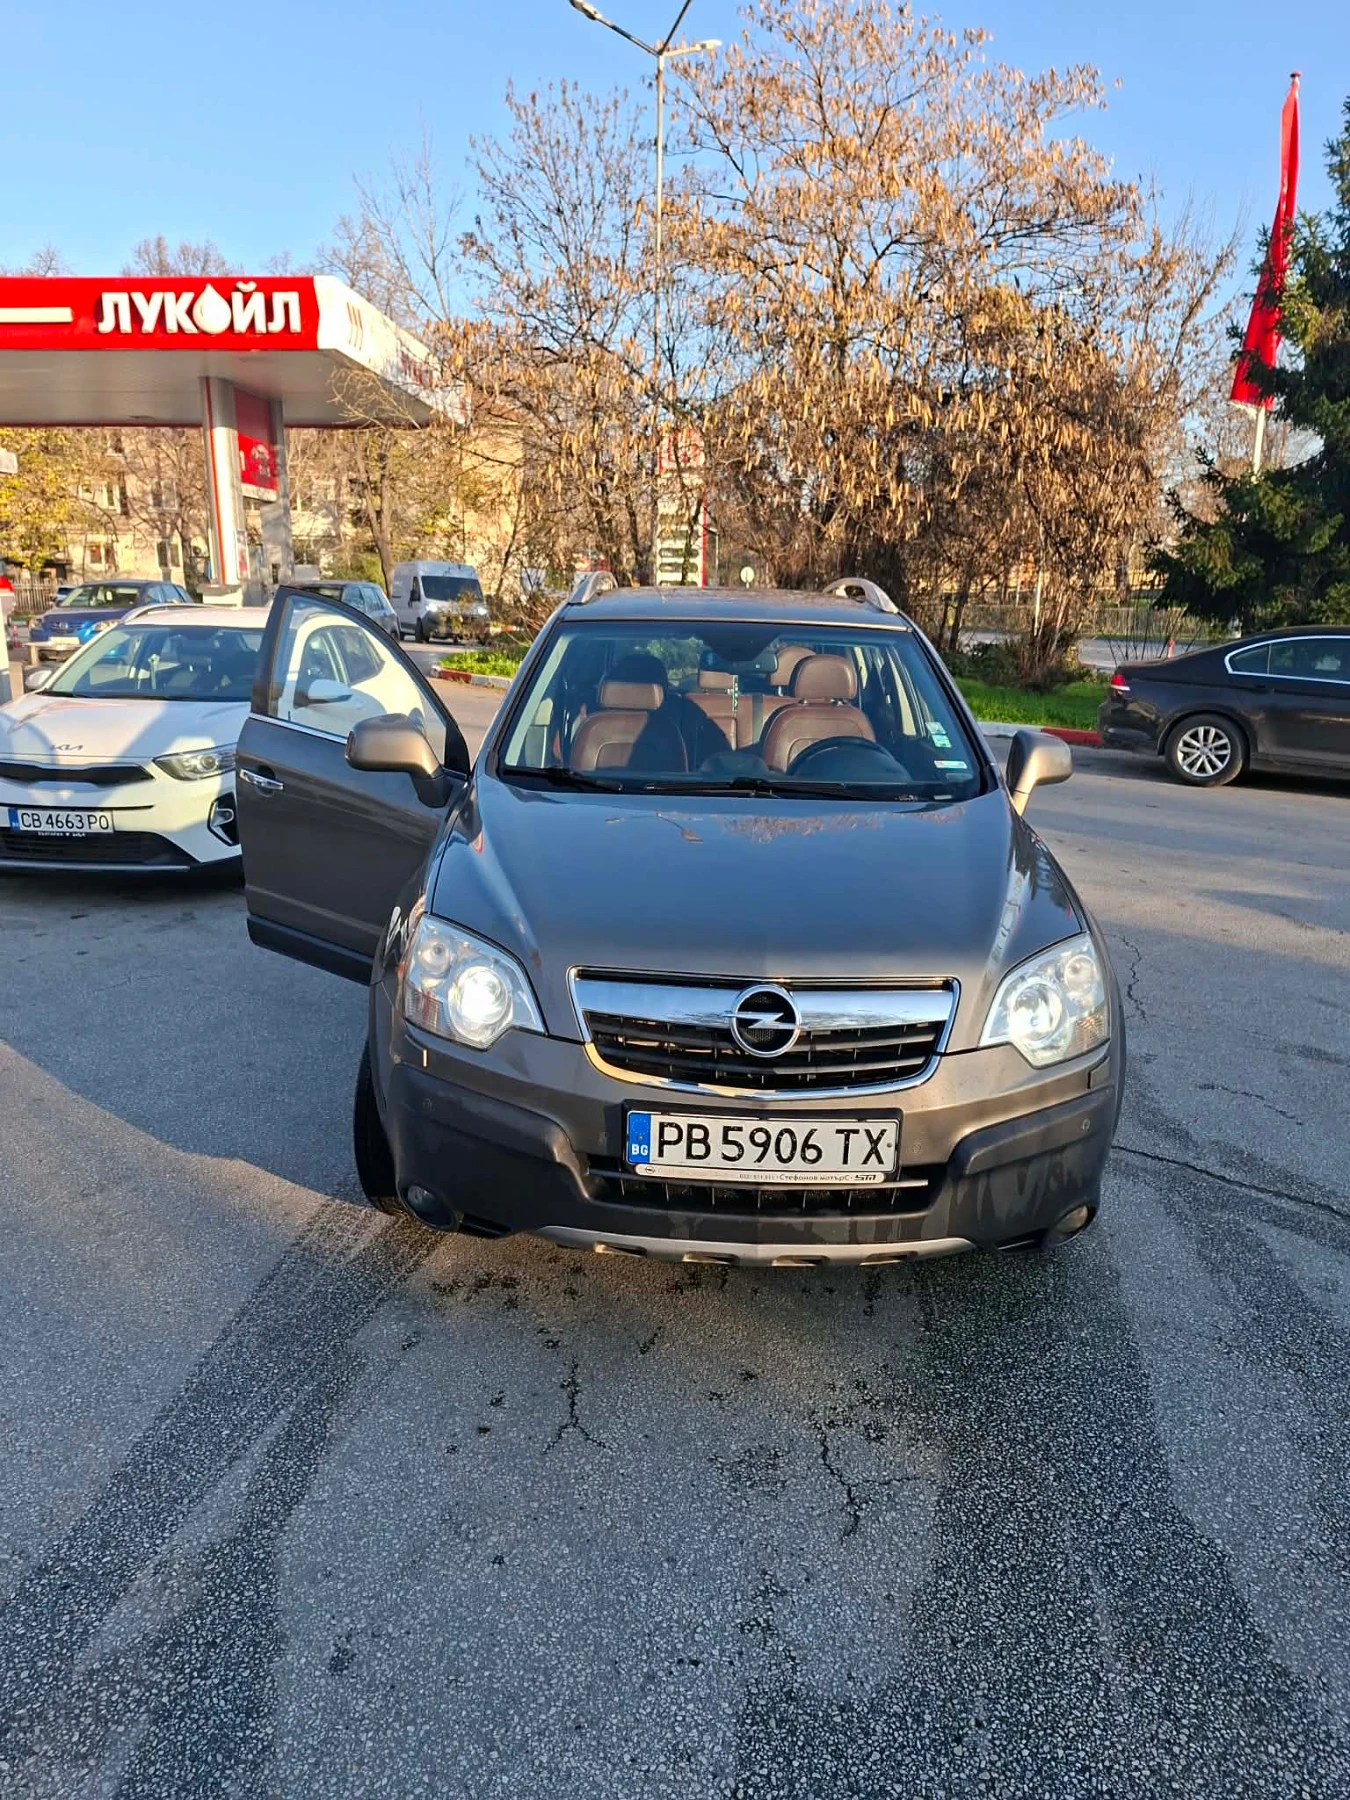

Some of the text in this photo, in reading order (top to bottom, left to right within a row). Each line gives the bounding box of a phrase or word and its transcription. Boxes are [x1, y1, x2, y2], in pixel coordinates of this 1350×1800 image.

[98, 281, 301, 335] ЛУКОЙЛ
[20, 812, 42, 828] CB
[45, 813, 85, 829] 4663
[87, 814, 110, 830] PO
[631, 1144, 648, 1156] BG
[657, 1121, 888, 1165] PB 5906 TX
